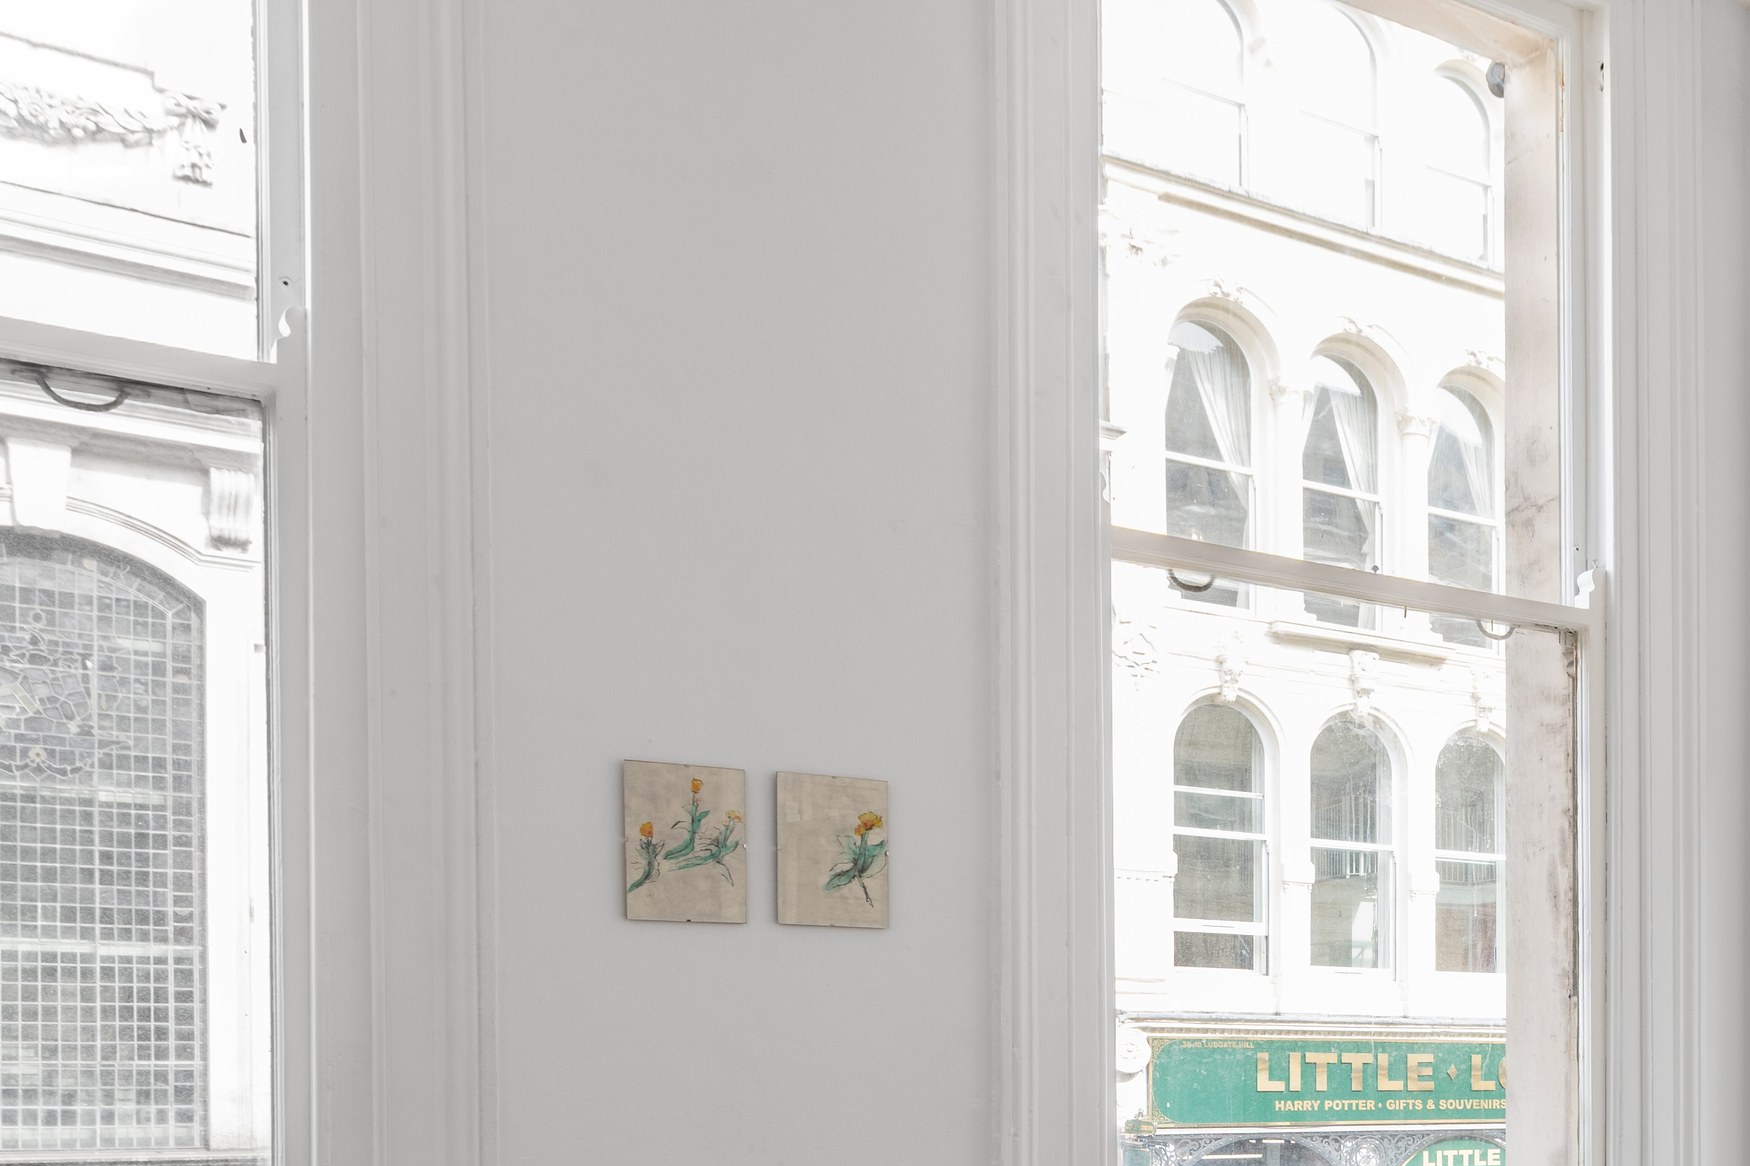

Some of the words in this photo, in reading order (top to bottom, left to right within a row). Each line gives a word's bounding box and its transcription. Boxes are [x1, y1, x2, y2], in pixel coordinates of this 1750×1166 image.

[1205, 1041, 1237, 1049] LUDGATE
[1239, 1041, 1255, 1049] HILL
[1256, 1052, 1434, 1092] LITTLE
[1471, 1053, 1506, 1092] L
[1275, 1100, 1320, 1111] HARRY
[1324, 1100, 1376, 1111] POTTER
[1386, 1099, 1423, 1110] GIFTS
[1426, 1099, 1436, 1110] &
[1439, 1099, 1506, 1110] SOUVENIRS
